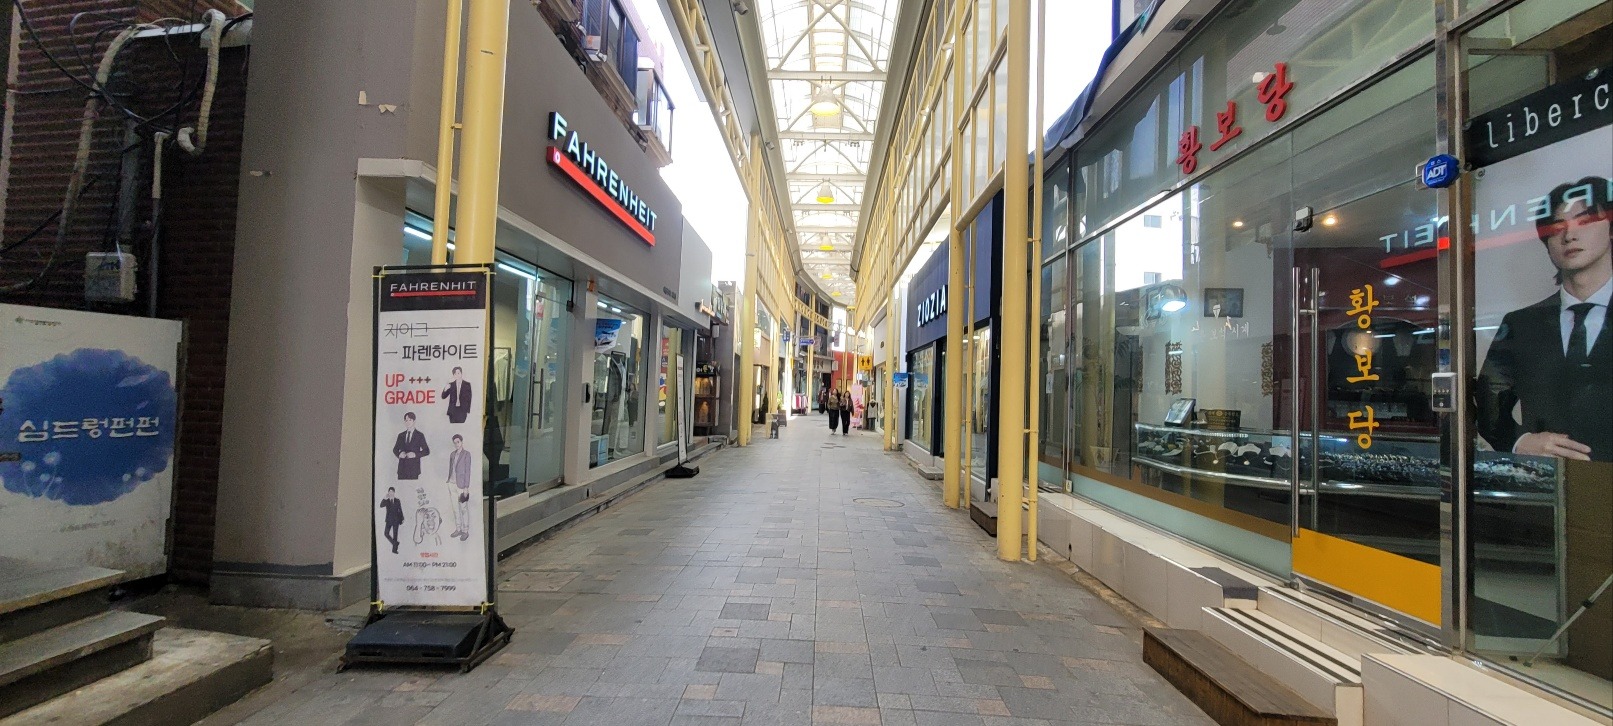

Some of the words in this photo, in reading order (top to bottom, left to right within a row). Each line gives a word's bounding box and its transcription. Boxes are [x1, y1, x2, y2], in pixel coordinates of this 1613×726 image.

[1176, 62, 1294, 175] 황보당
[550, 111, 657, 231] FAHRENHEIT
[1426, 163, 1447, 180] ADT
[390, 281, 477, 292] FAHRENHIT
[917, 284, 948, 328] ZIOZIA
[401, 344, 478, 361] 파렌하이트
[1346, 284, 1380, 450] 황보당
[385, 374, 405, 388] UP
[384, 390, 436, 405] GRADE
[18, 416, 159, 443] 심드렁펀펀
